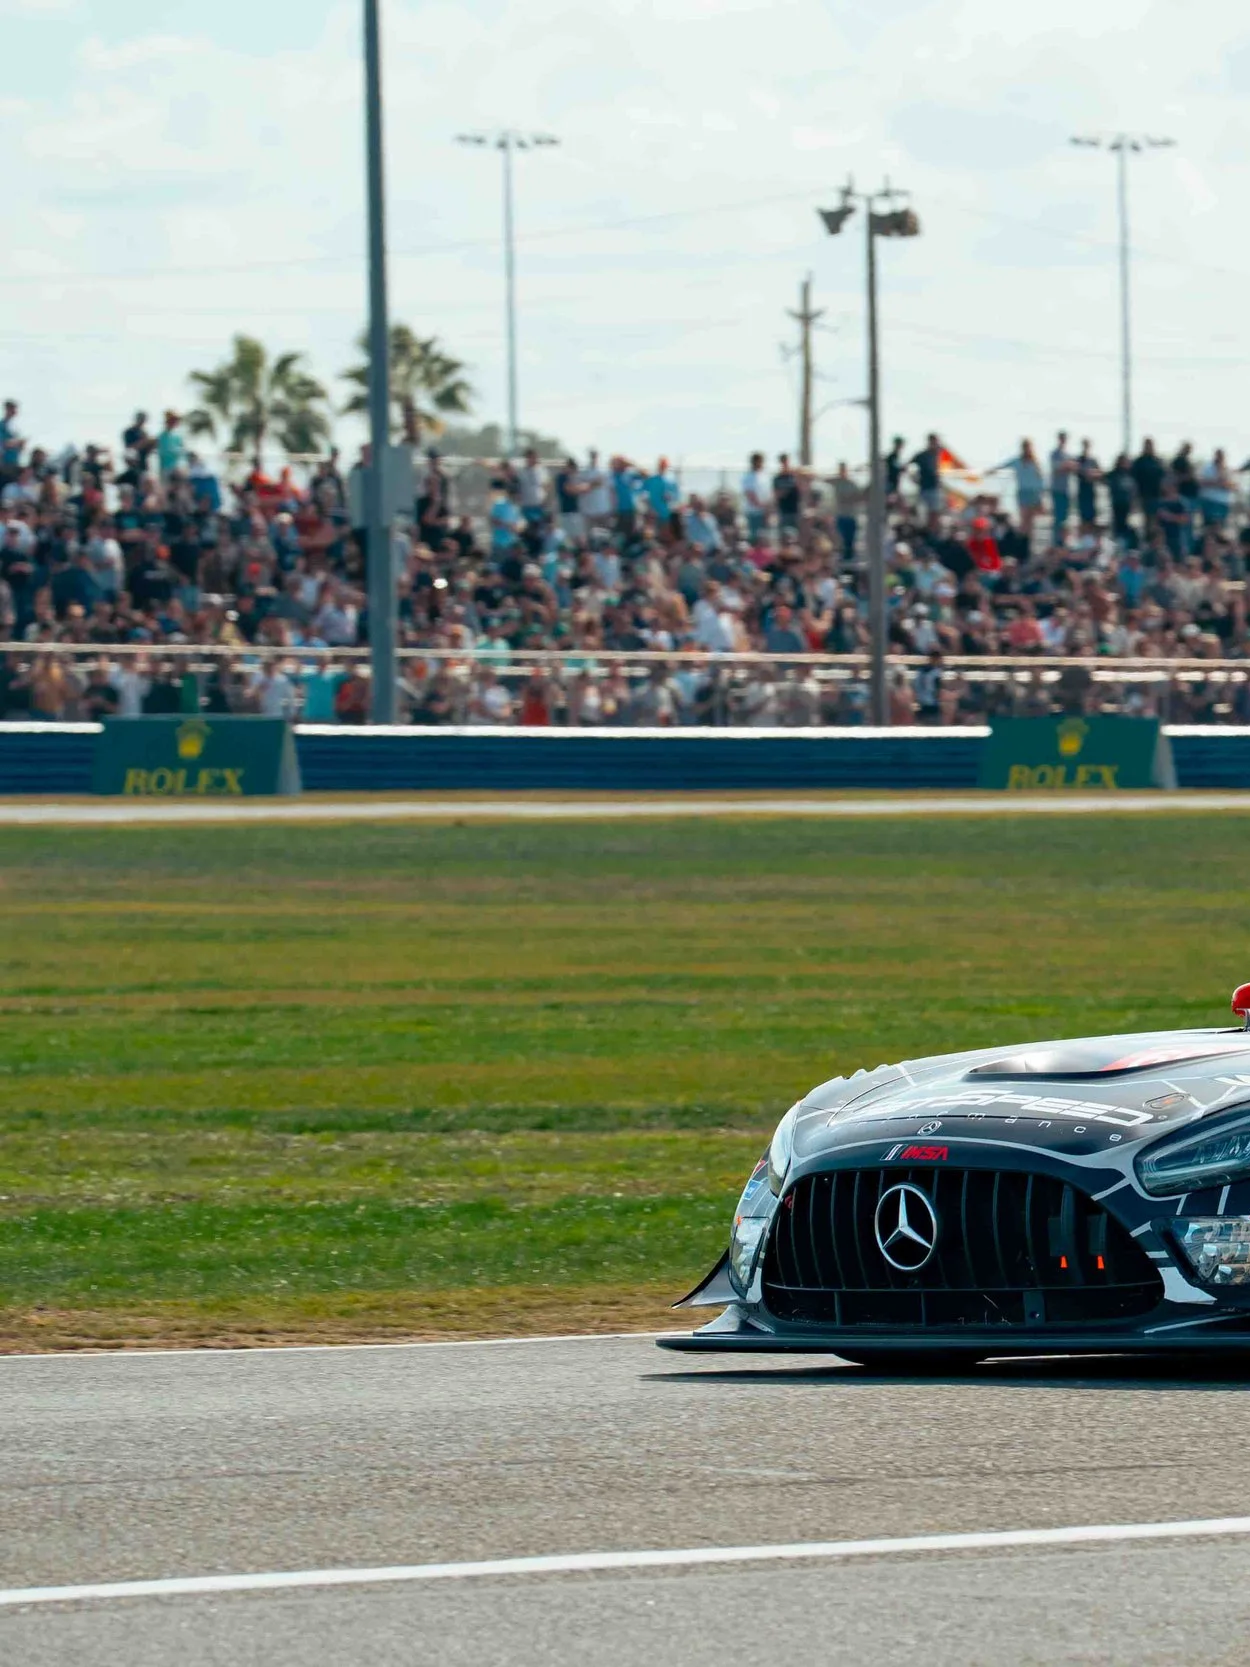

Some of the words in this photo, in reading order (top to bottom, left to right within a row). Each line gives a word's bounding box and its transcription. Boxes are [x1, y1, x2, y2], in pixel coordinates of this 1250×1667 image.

[123, 768, 245, 795] ROLEX
[1008, 764, 1118, 788] ROLEX
[899, 1145, 949, 1161] IMSA
